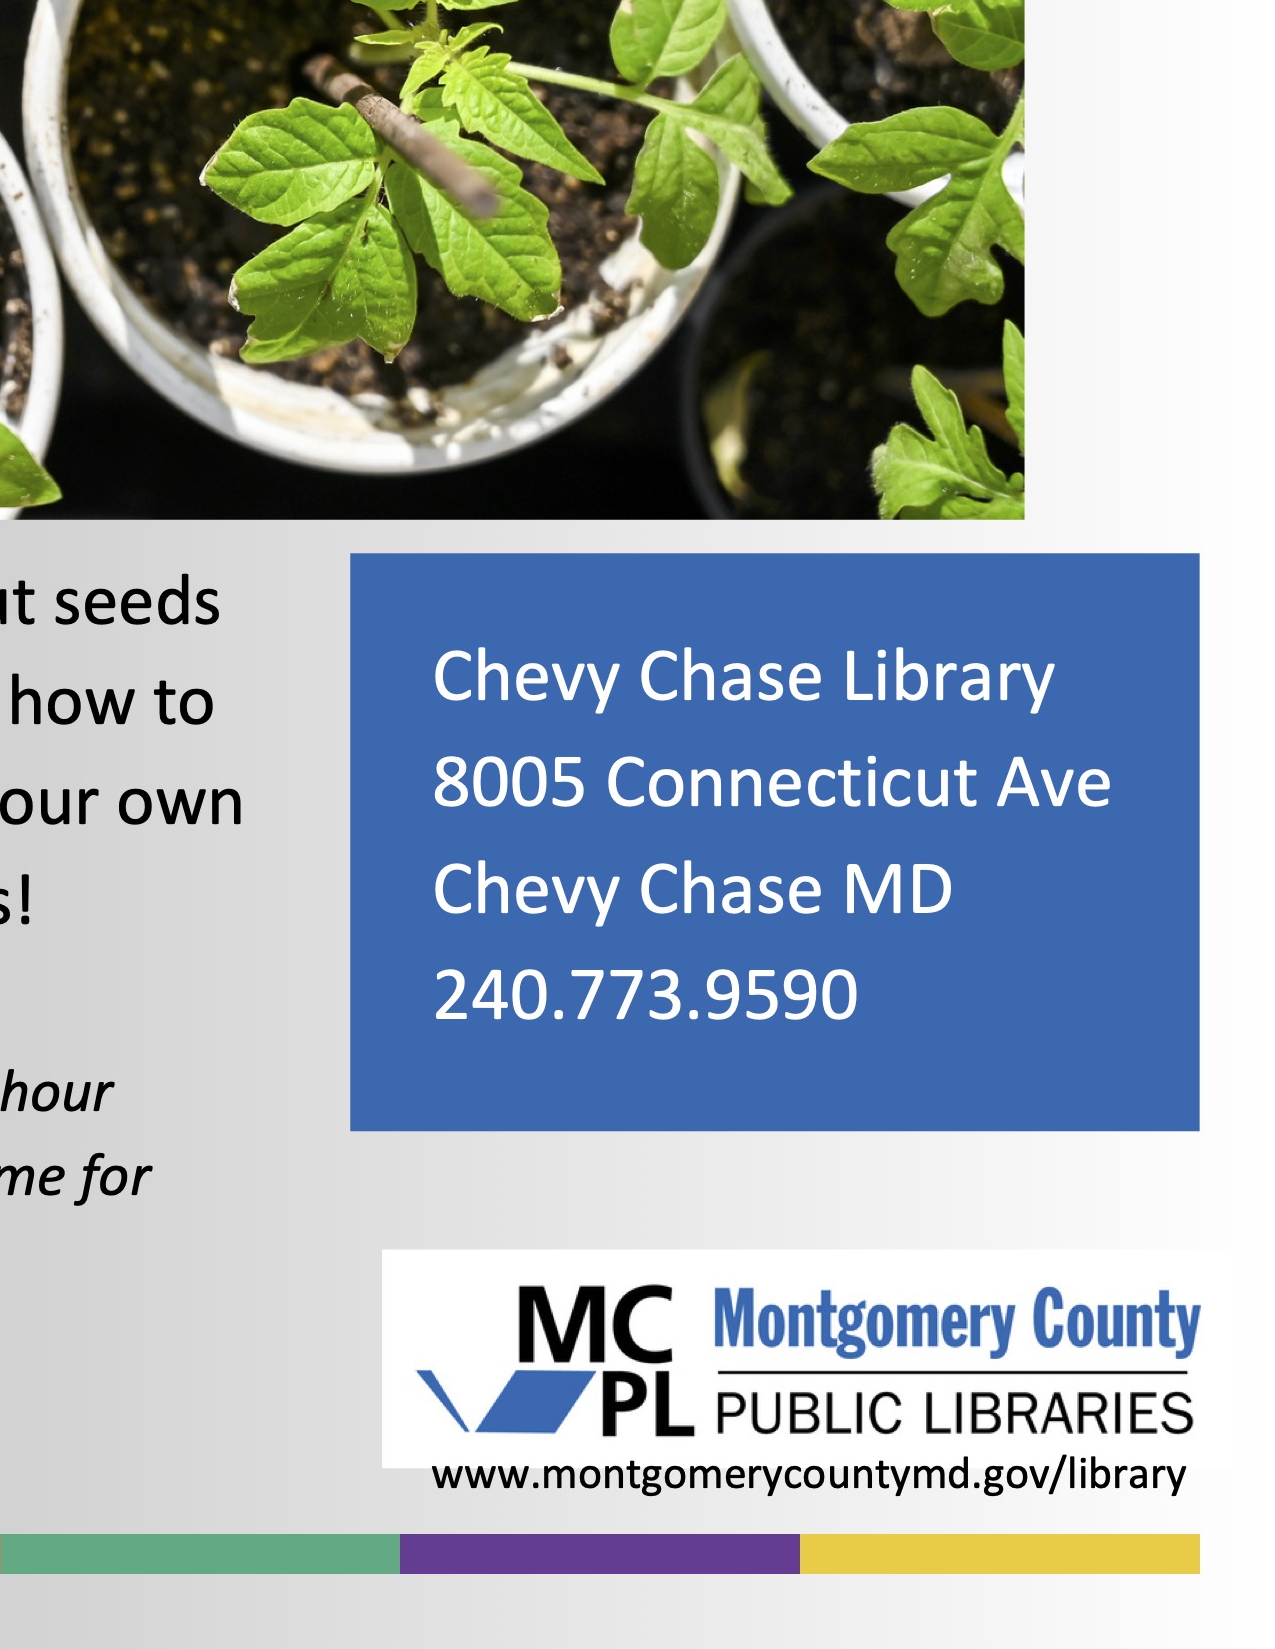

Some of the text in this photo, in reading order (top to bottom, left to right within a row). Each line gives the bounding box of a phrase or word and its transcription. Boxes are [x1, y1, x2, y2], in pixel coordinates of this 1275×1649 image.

[55, 573, 219, 625] seeds
[12, 673, 135, 725] how
[154, 680, 213, 725] to
[435, 647, 1055, 714] Chevy Chase Library
[119, 788, 241, 825] own
[435, 756, 1110, 807] 8005 Connecticut Ave
[435, 860, 951, 927] Chevy Chase MD
[436, 969, 857, 1020] 240.773.9590
[0, 1069, 115, 1112] hour
[74, 1153, 153, 1206] for
[519, 1284, 672, 1364] MC
[715, 1287, 1201, 1359] Montgomery County
[602, 1371, 695, 1437] PL
[718, 1392, 1194, 1434] PUBLIC LIBRARIES
[432, 1455, 1186, 1496] www.montgomerycountymd.gov/library
